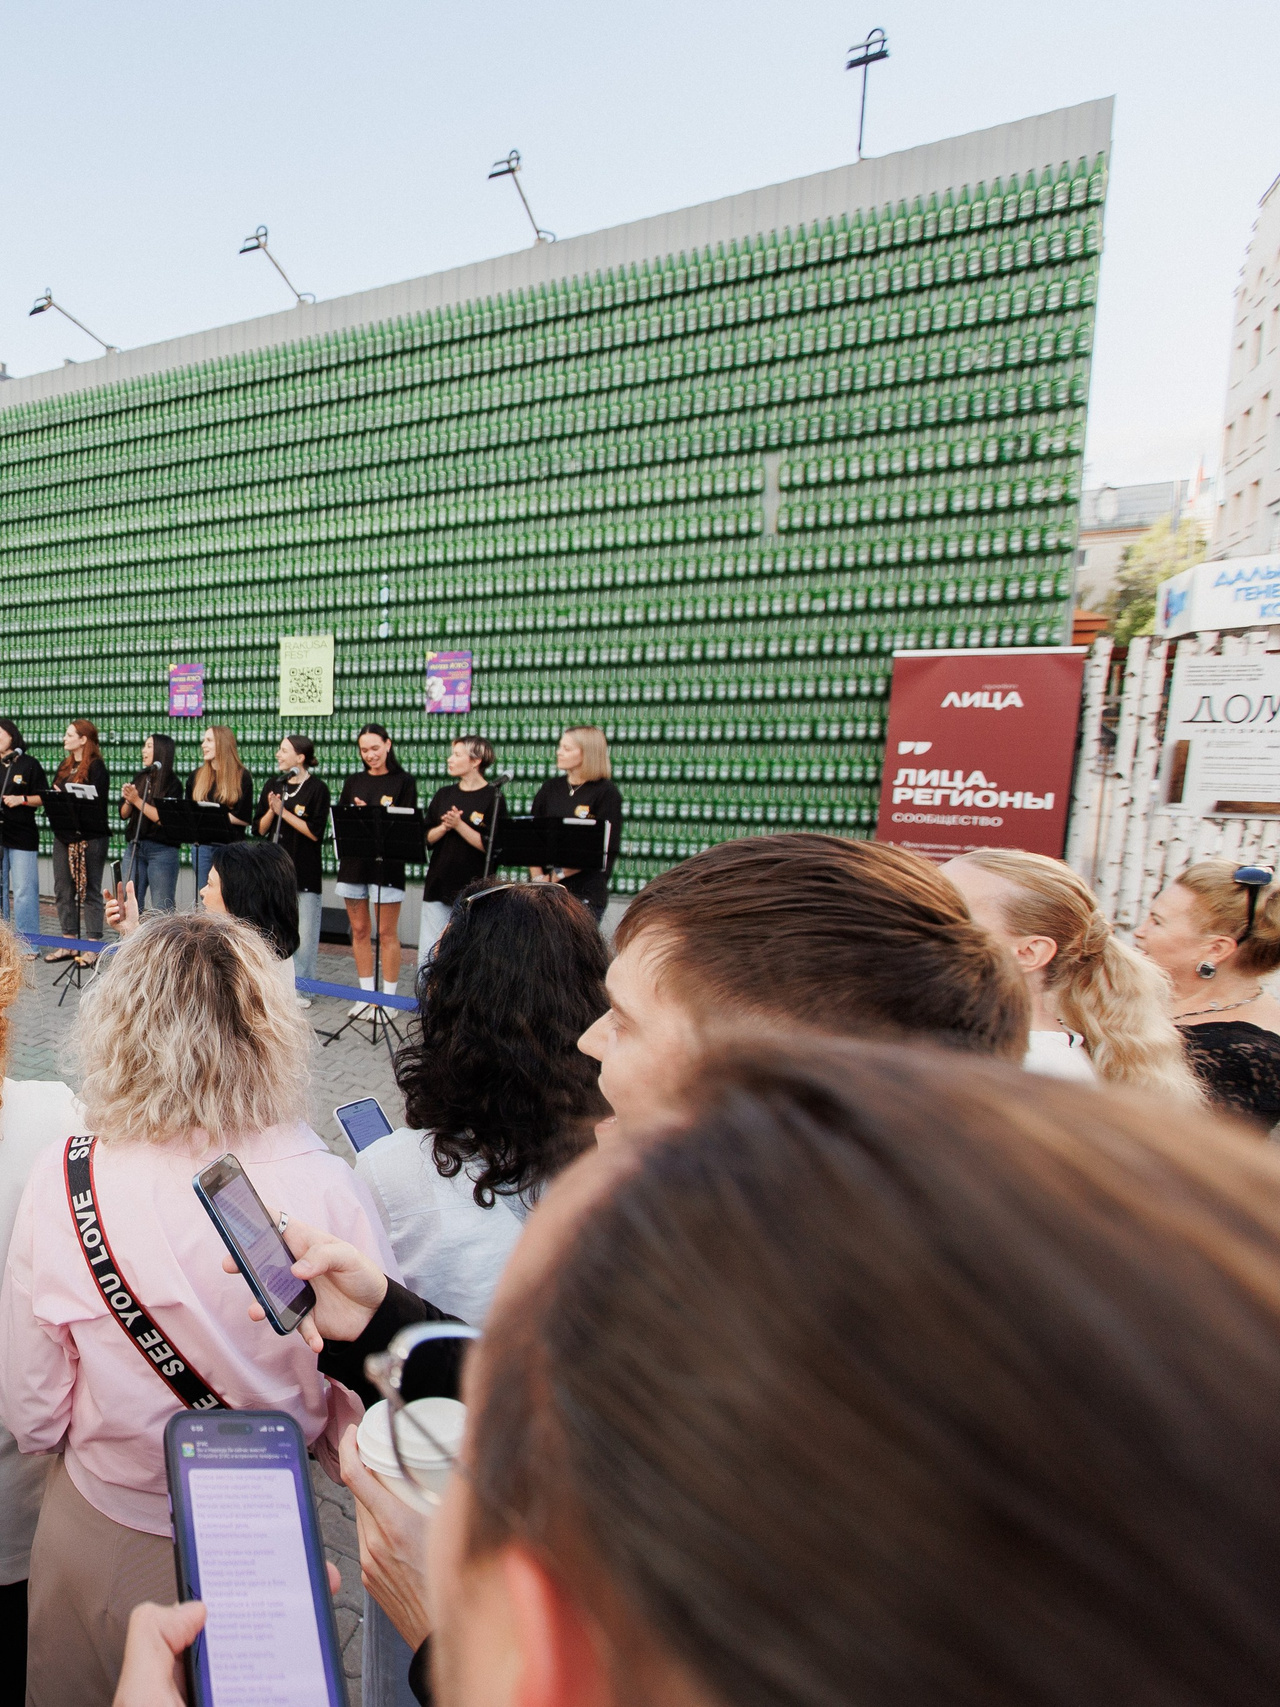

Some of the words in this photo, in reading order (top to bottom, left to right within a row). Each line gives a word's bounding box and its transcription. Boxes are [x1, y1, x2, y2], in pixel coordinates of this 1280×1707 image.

[284, 639, 328, 650] RAKUSA
[284, 650, 311, 659] FEST
[940, 691, 1024, 710] ЛИЦА
[892, 768, 998, 790] ЛИЦА.
[892, 787, 1055, 811] РЕГИОНЫ
[891, 811, 1004, 828] СООБЩЕСТВО
[68, 1135, 94, 1161] SE
[72, 1189, 110, 1266] LOVE
[98, 1272, 143, 1328] YOU
[136, 1328, 185, 1377] SEE
